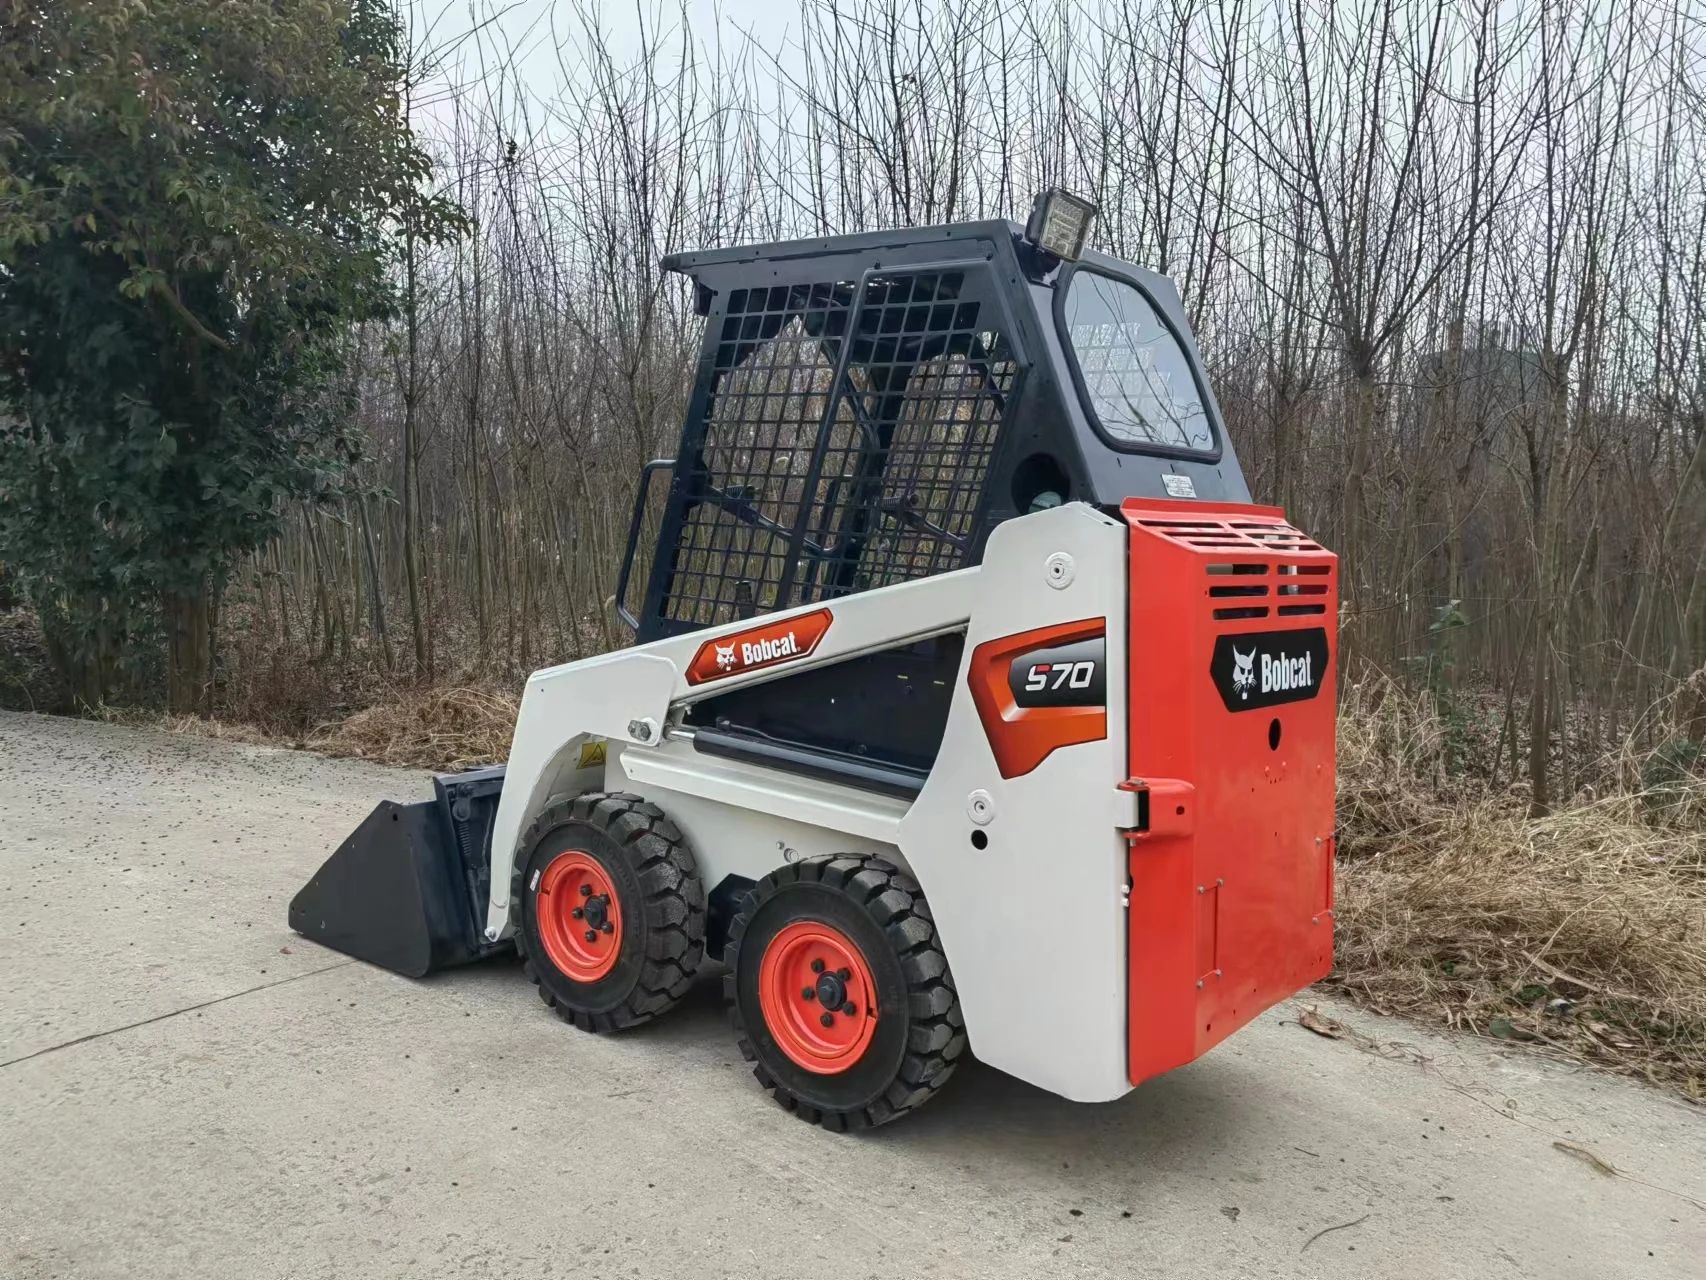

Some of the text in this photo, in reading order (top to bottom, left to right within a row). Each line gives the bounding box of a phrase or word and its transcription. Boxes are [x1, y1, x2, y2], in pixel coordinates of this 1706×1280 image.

[741, 631, 798, 666] Bobcat
[1025, 661, 1095, 691] S70
[1261, 650, 1312, 693] Bobcat
